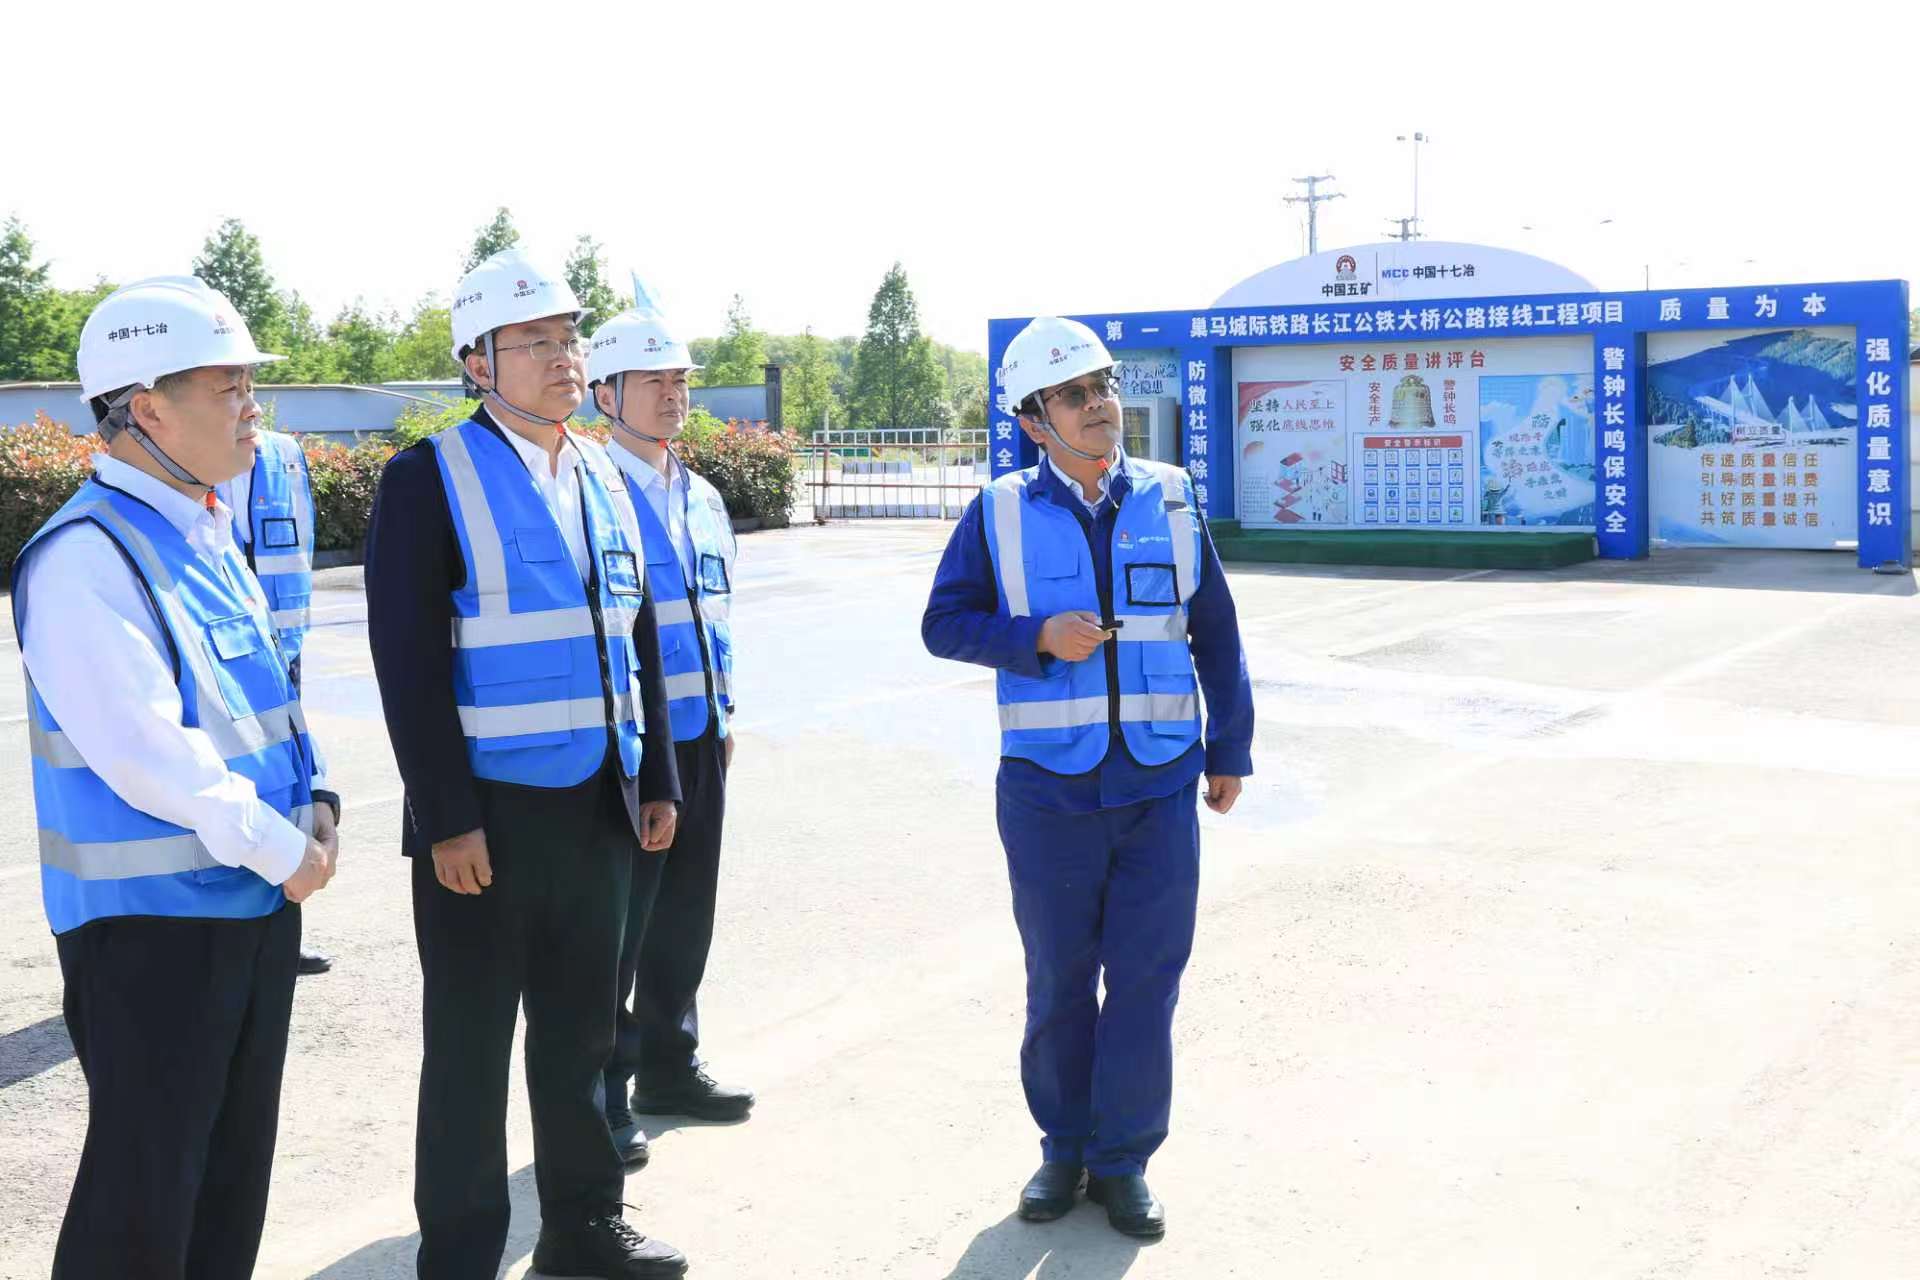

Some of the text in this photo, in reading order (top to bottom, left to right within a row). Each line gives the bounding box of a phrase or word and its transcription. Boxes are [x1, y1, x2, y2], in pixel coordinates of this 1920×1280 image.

[1382, 264, 1475, 279] MCC 中国十七冶
[1321, 282, 1373, 297] 中国五矿
[1659, 292, 1826, 321] 质量为本
[1190, 301, 1622, 338] 巢马城际铁路长江公铁大桥公路接线工程项目
[108, 322, 168, 341] 中国十七冶
[1340, 350, 1485, 371] 安全质量讲评台
[1368, 382, 1381, 426] 安全生产
[1443, 378, 1457, 425] 警钟长鸣
[1603, 347, 1627, 533] 警钟长鸣保安全
[1865, 338, 1892, 526] 强化质量意识
[1701, 453, 1817, 467] 传递质量信任
[1701, 472, 1817, 487] 引导质量消费
[1701, 511, 1818, 527] 共筑质量诚信
